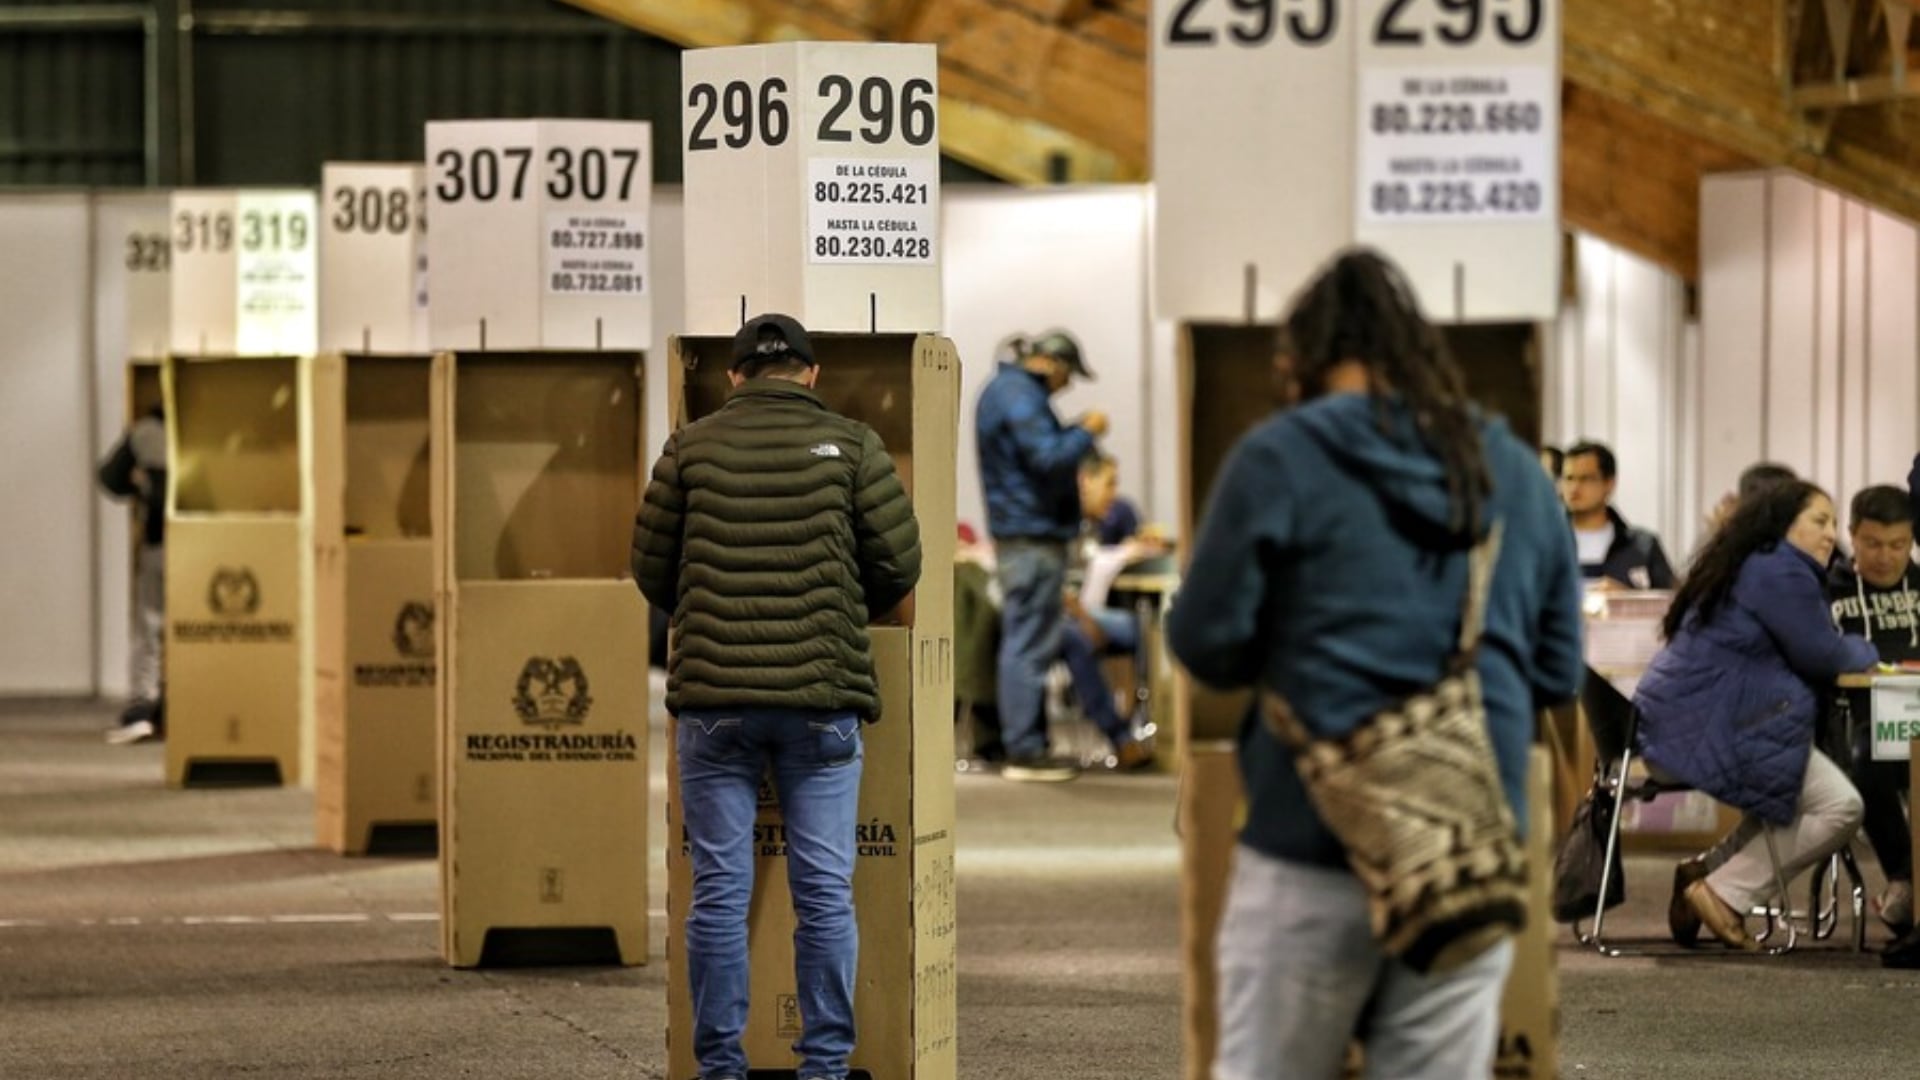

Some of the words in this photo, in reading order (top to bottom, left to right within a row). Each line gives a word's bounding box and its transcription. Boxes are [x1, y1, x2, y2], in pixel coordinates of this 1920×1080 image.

[688, 77, 789, 151] 296
[816, 74, 935, 146] 296
[436, 147, 534, 203] 307
[547, 147, 640, 202] 307
[835, 164, 849, 177] DE
[852, 165, 865, 177] LA
[868, 164, 908, 178] CÉDULA
[332, 186, 410, 235] 308
[815, 181, 928, 204] 80.225.421
[175, 210, 235, 253] 319
[243, 210, 308, 252] 319
[827, 218, 860, 230] HASTA
[862, 220, 875, 231] LA
[877, 219, 918, 232] CÉDULA
[815, 235, 930, 259] 80.230.428
[467, 729, 637, 750] REGISTRADURÍA
[858, 845, 897, 857] CIVIL
